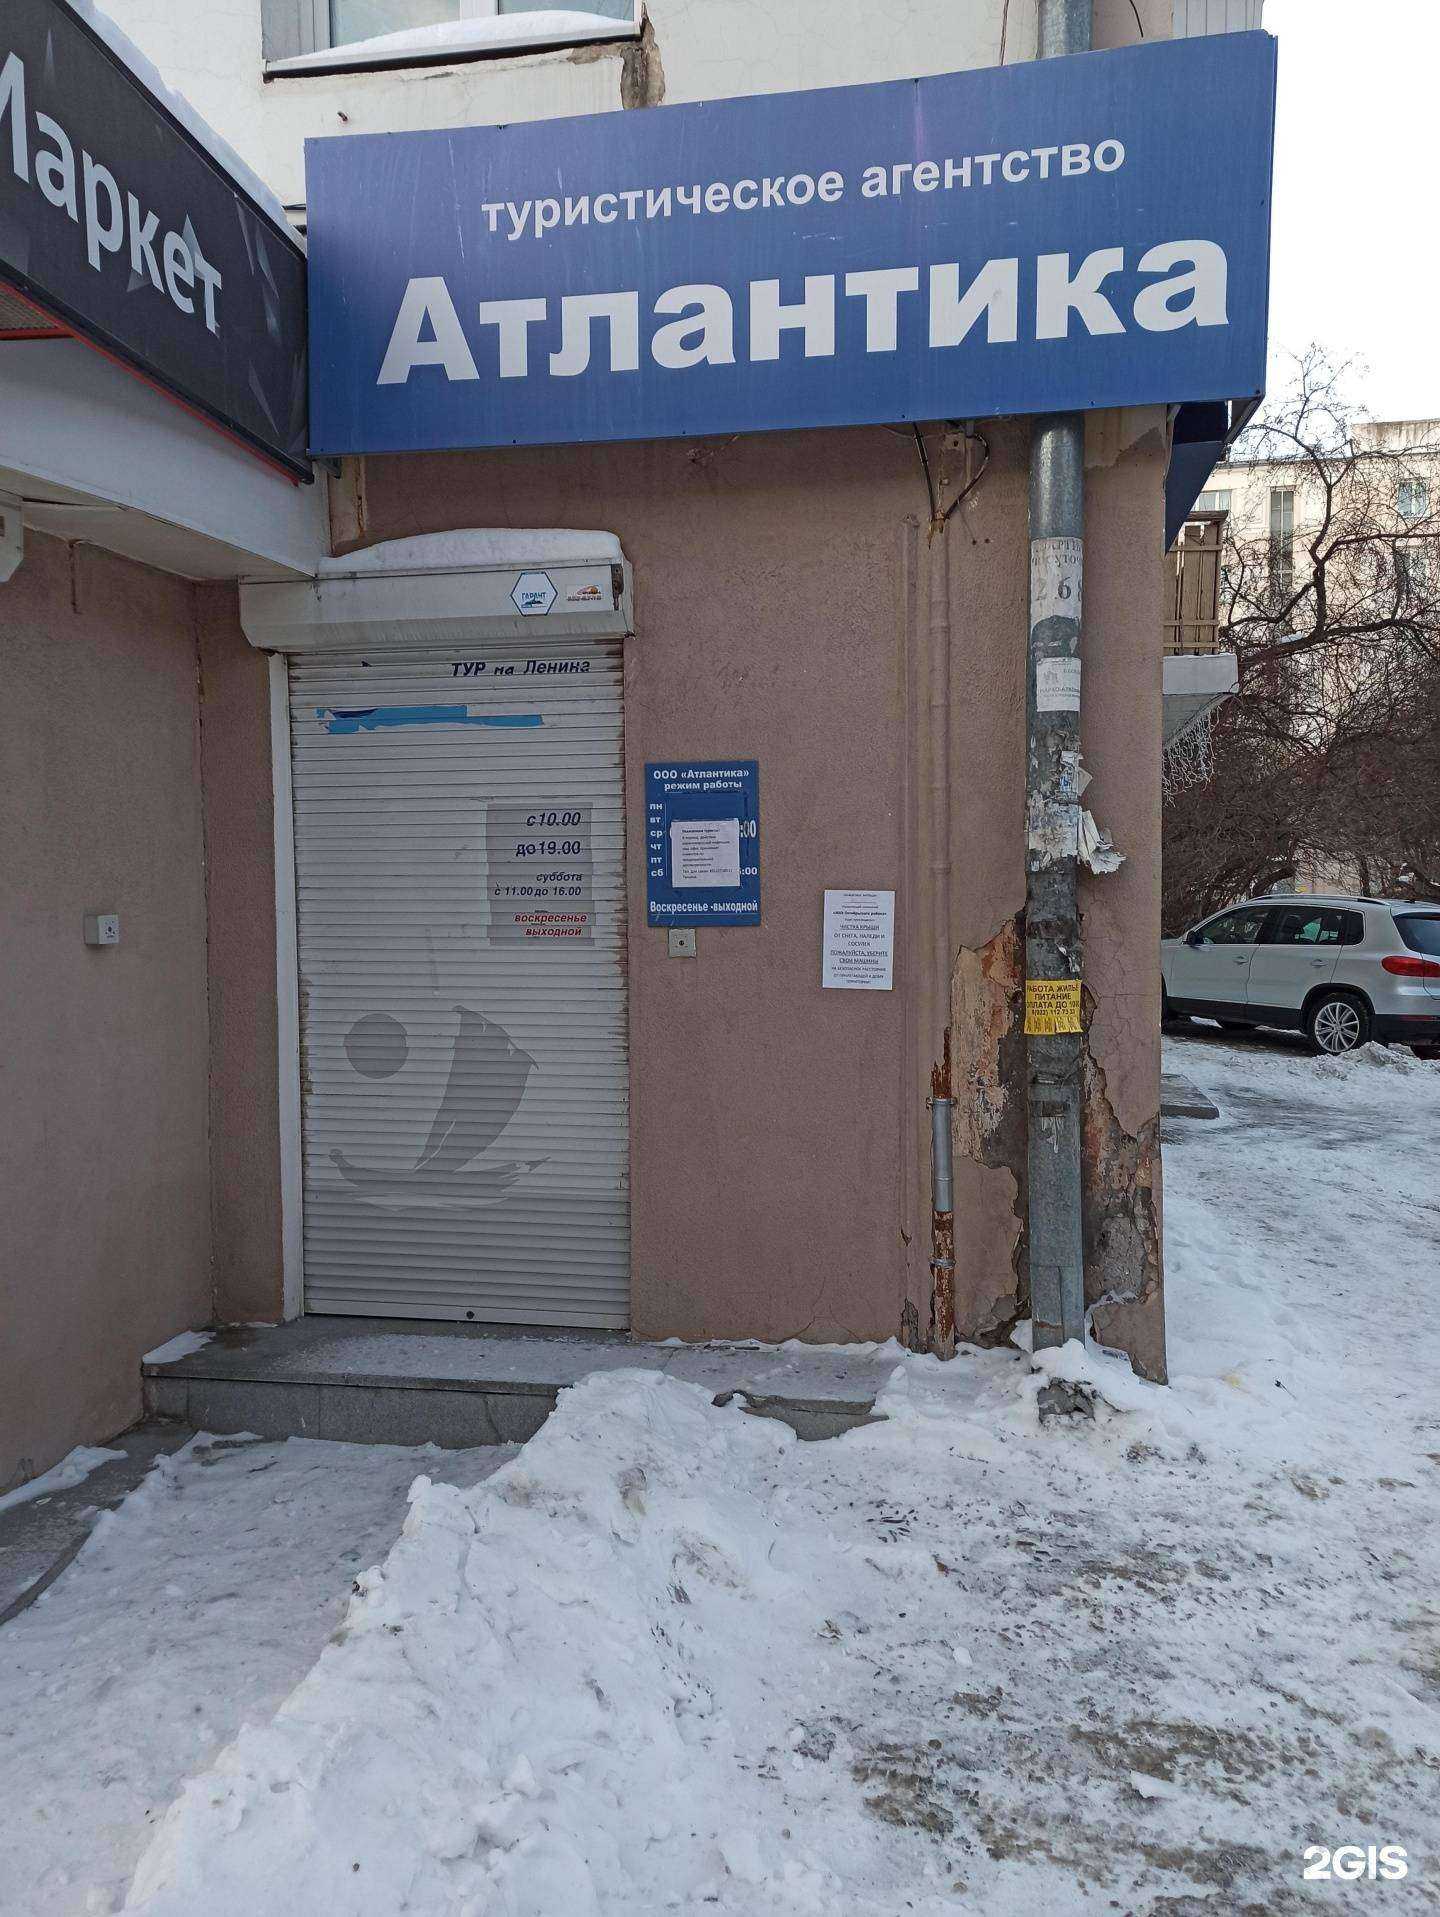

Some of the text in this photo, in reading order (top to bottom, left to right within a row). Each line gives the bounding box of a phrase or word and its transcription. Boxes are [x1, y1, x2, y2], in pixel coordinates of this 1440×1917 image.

[481, 138, 1126, 241] туристическое агентство
[376, 239, 1230, 385] Атлантика
[451, 660, 591, 677] ТУР на Ленина
[653, 769, 750, 780] ООО «Атлантика»
[664, 779, 742, 792] режим работы
[650, 830, 663, 839] ср
[651, 868, 664, 877] сб
[739, 867, 758, 876] :00
[536, 871, 584, 884] суббота
[553, 886, 582, 896] 16.00
[650, 901, 709, 915] Воскресенье
[514, 913, 588, 923] воскресенье
[525, 927, 582, 937] выходной
[1034, 992, 1072, 1001] ПИТАНИЕ
